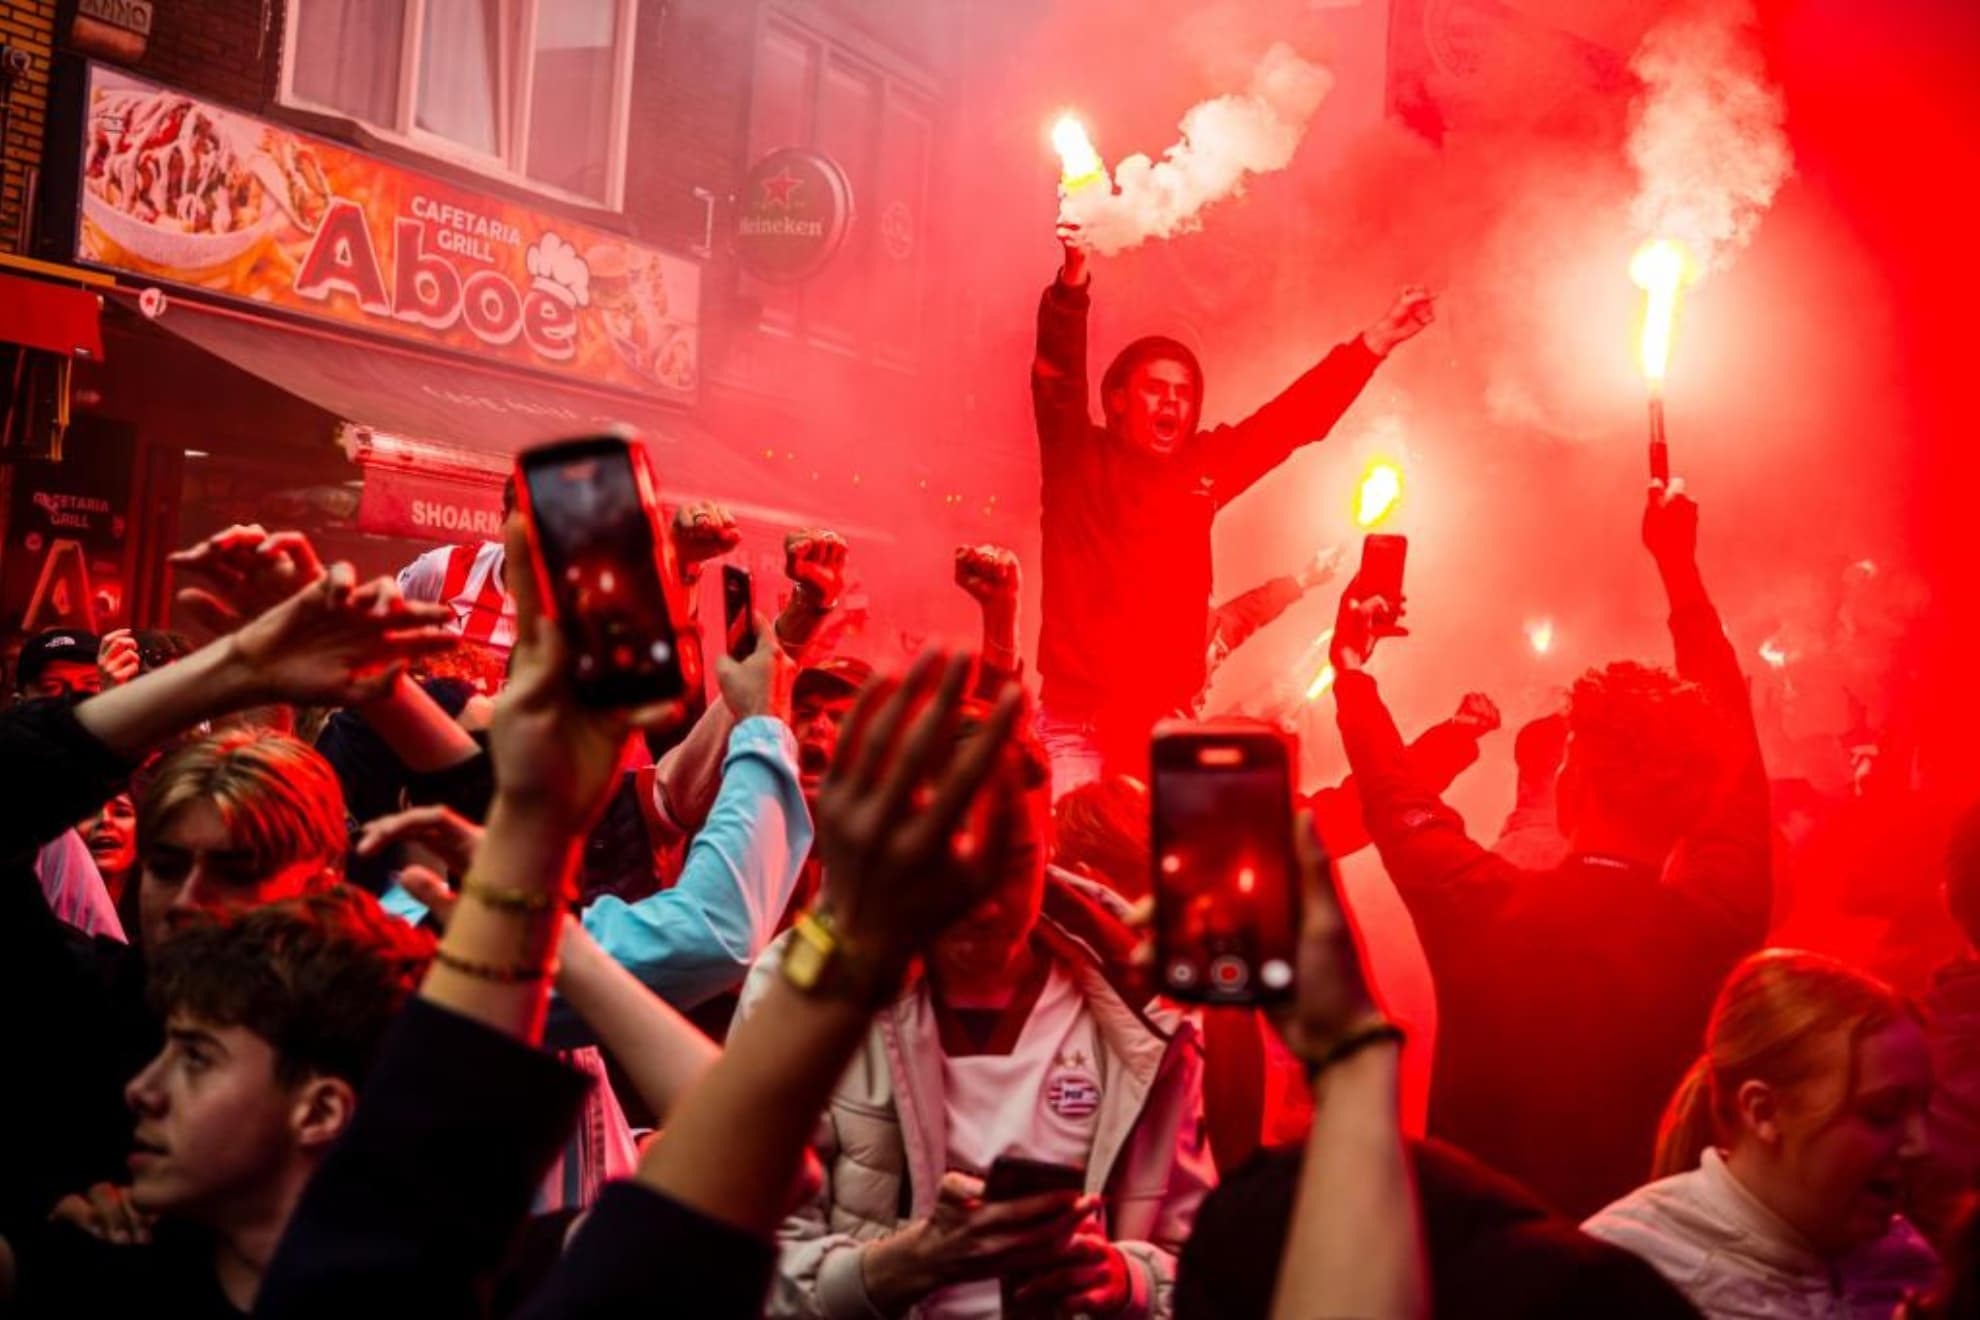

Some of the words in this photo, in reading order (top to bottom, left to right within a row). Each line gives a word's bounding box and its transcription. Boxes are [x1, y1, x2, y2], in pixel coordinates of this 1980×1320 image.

[411, 196, 520, 246] CAFETARIA
[437, 229, 495, 263] GRILL
[293, 197, 577, 359] Aboe
